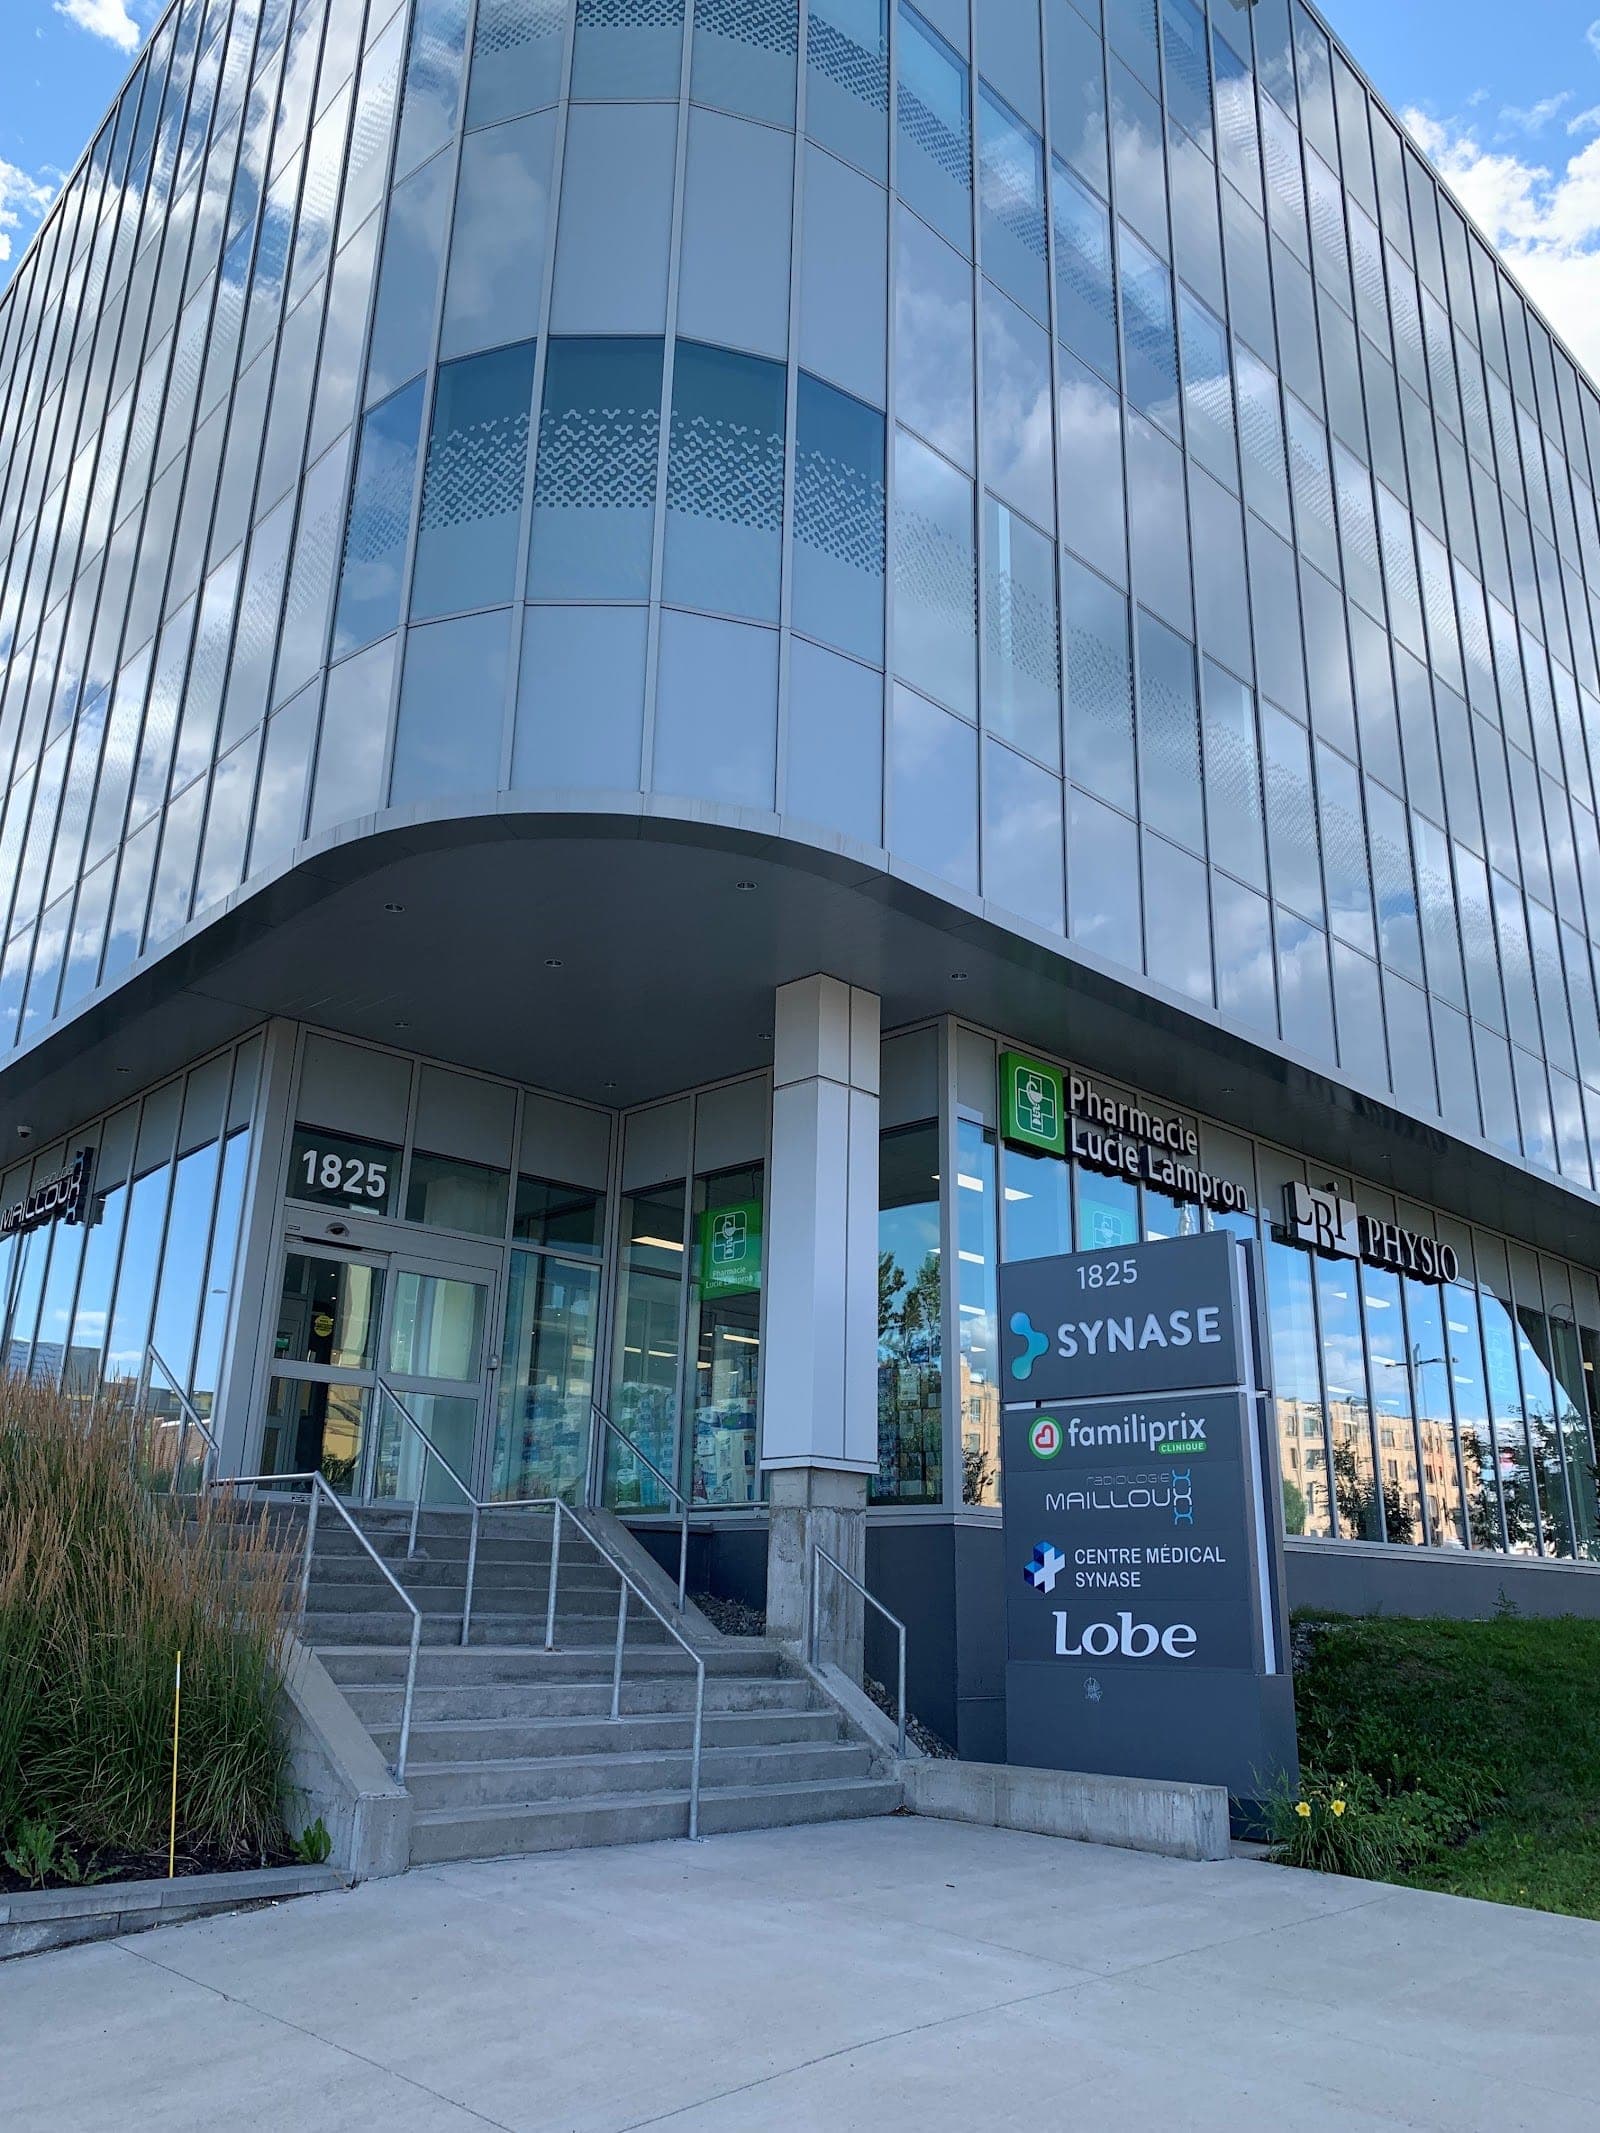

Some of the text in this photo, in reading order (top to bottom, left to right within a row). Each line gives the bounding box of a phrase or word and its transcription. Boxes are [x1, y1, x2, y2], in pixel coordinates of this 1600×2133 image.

[1070, 1075, 1198, 1156] Pharmacie
[301, 1149, 388, 1199] 1825
[1071, 1115, 1249, 1211] Lucie Lampron
[1366, 1215, 1459, 1284] PHYSIO
[1076, 1259, 1138, 1290] 1825
[1057, 1306, 1222, 1358] SYNASE
[1067, 1411, 1207, 1452] familiprix
[1160, 1442, 1205, 1454] CLINIQUE
[1046, 1486, 1193, 1512] MAILLOUX
[1074, 1543, 1227, 1565] CENTRE MÉDICAL
[1075, 1571, 1142, 1588] SYNASE
[1052, 1610, 1198, 1659] Lobe
